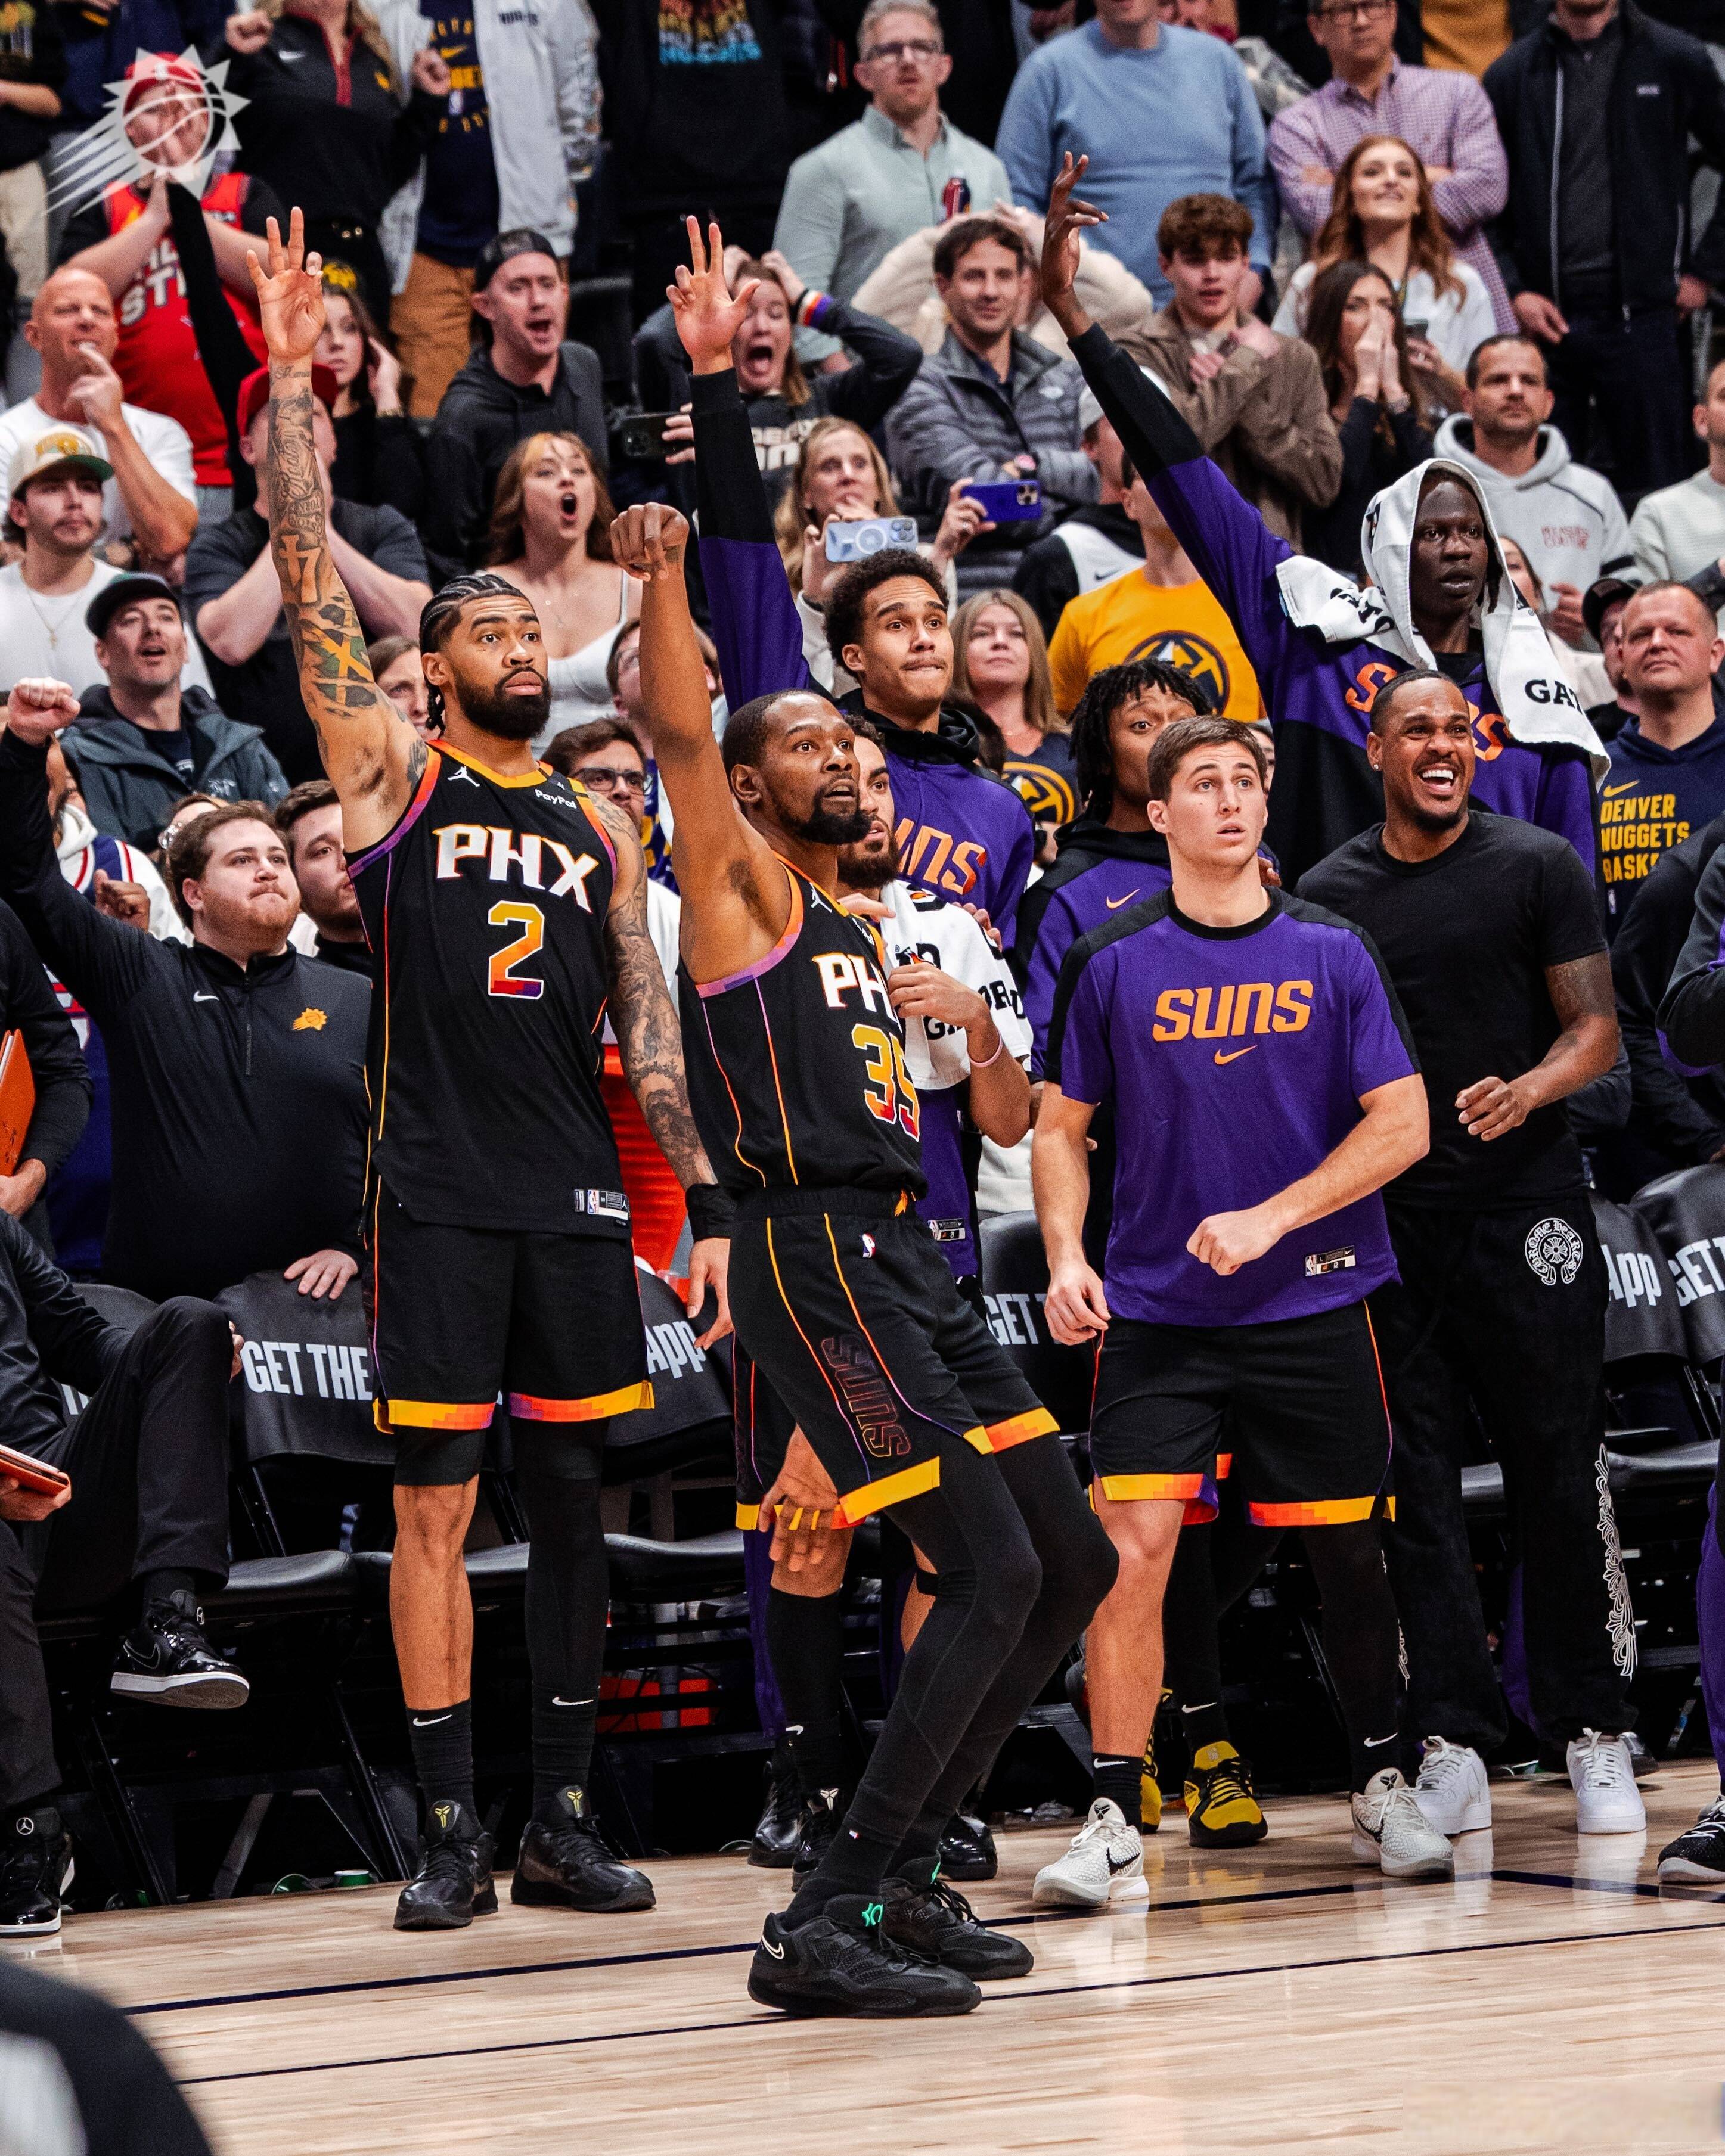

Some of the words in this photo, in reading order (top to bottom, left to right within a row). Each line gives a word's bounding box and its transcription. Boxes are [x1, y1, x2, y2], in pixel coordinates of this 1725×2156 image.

[534, 788, 577, 809] PayPal
[1600, 794, 1676, 824] DENVER
[1601, 821, 1690, 853] NUGGETS
[432, 824, 600, 915] PHX
[488, 900, 545, 1000] 2
[811, 952, 902, 1033] PH
[1152, 980, 1314, 1042] SUNS
[851, 1022, 920, 1143] 35
[1667, 1239, 1725, 1307] GET
[644, 1320, 706, 1379] App
[982, 1293, 1039, 1346] GET
[240, 1340, 304, 1396] GET
[305, 1343, 373, 1402] THE
[821, 1337, 911, 1458] SUNS
